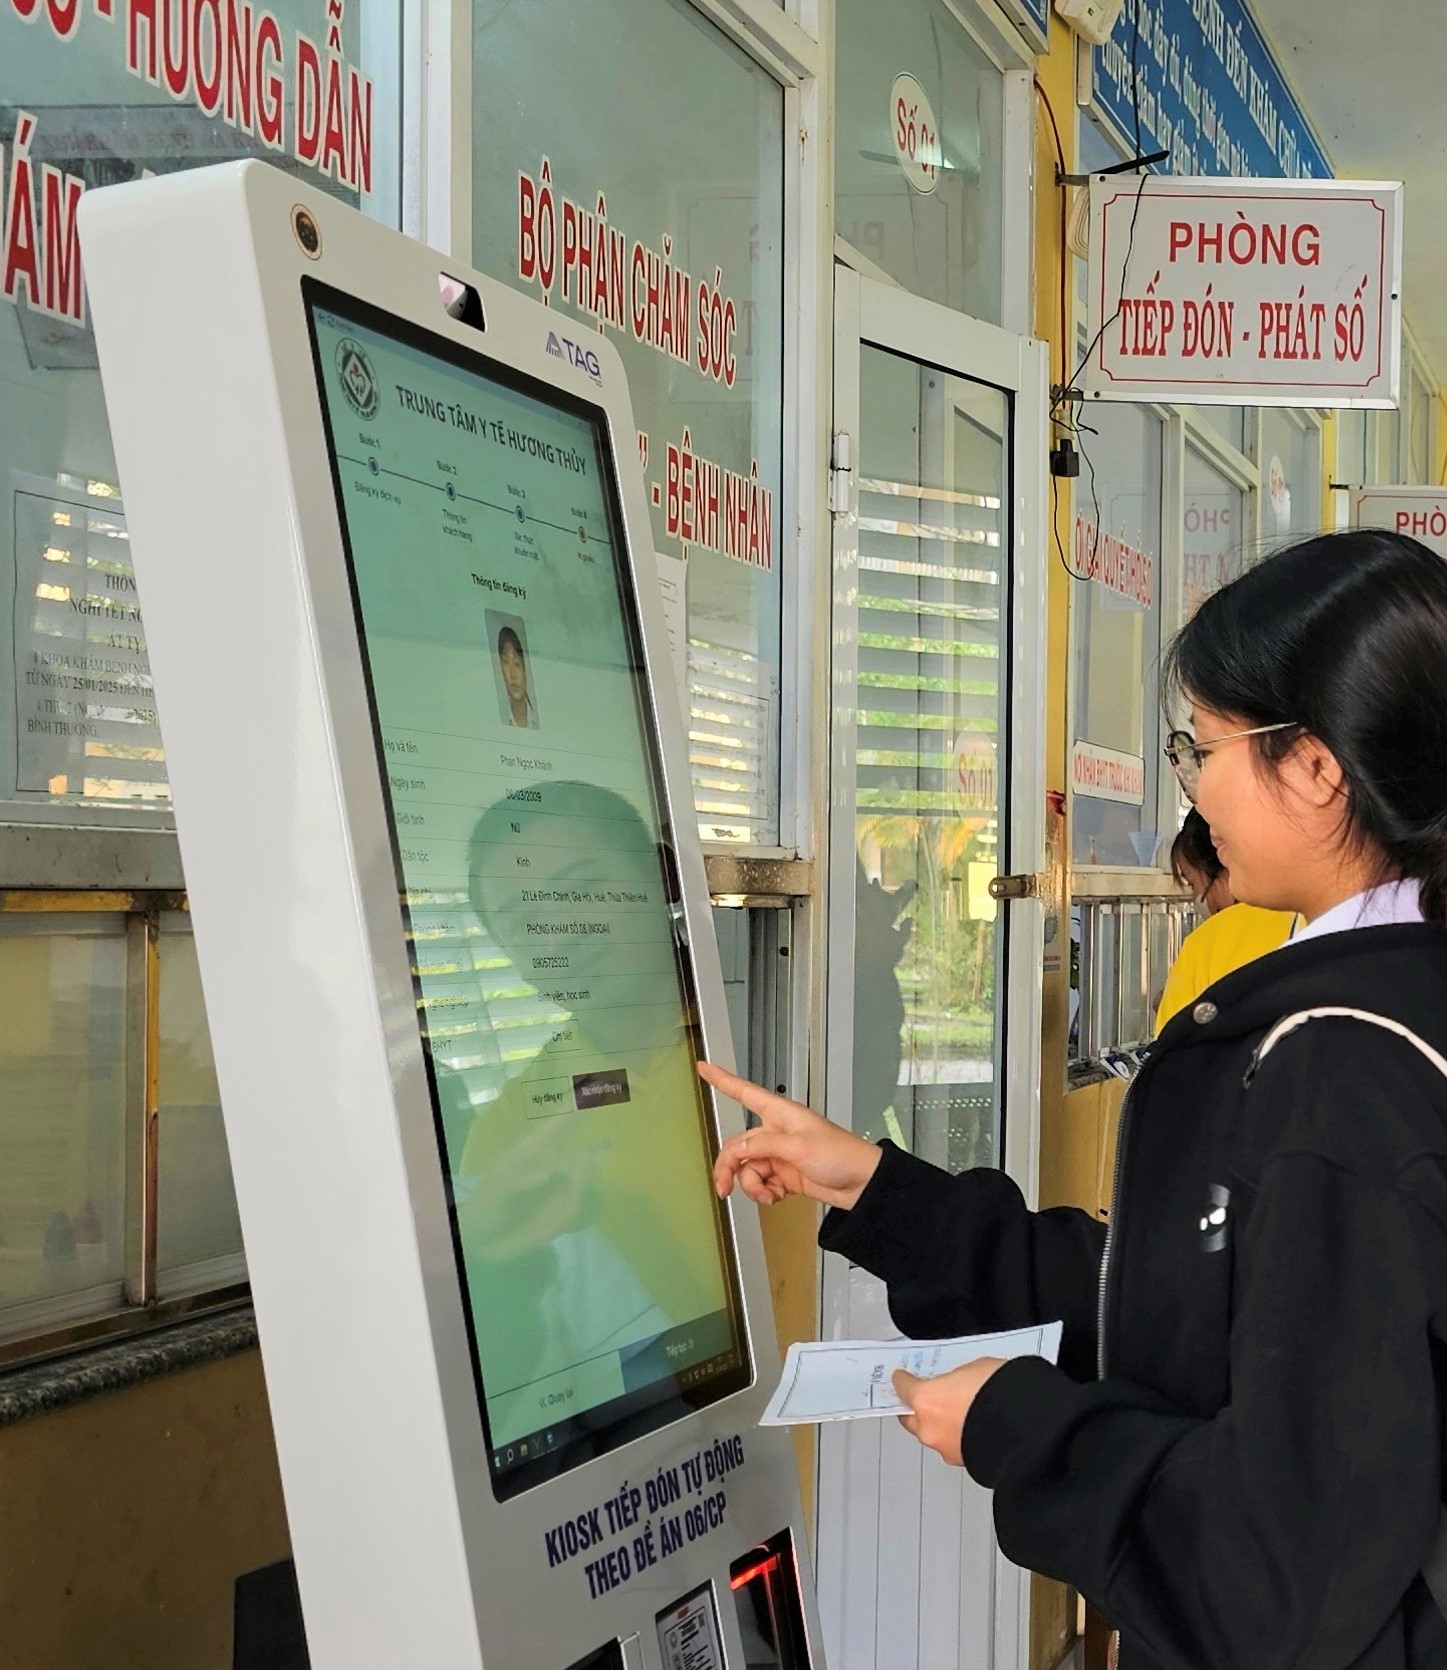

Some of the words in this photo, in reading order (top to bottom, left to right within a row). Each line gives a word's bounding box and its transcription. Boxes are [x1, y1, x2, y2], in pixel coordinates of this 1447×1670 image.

[297, 0, 373, 194] DẪN
[897, 97, 918, 161] Số
[520, 160, 555, 307] BỘ
[562, 196, 625, 335] PHẬN
[632, 235, 690, 362] CHĂM
[698, 269, 737, 387] SÓC
[1168, 210, 1321, 267] PHÒNG
[561, 337, 602, 377] TAG
[1118, 270, 1175, 357] TIẾP
[1181, 282, 1235, 359] ĐÓN
[1258, 284, 1327, 361] PHÁT
[1333, 274, 1368, 362] SỐ
[395, 384, 446, 423] TRUNG
[447, 403, 478, 435] TÂM
[478, 416, 487, 438] Y
[489, 420, 506, 445] TẾ
[506, 428, 555, 464] HƯƠNG
[555, 446, 586, 476] THỦY
[668, 430, 720, 560] BỆNH
[724, 460, 772, 570] NHÂN
[544, 1507, 604, 1568] KIOSK
[604, 1480, 641, 1535] TIẾP
[645, 1466, 681, 1514] ĐÓN
[681, 1452, 703, 1496] TỰ
[703, 1434, 745, 1483] ĐỘNG
[584, 1545, 631, 1600] THEO
[632, 1520, 658, 1573] ĐỀ
[658, 1516, 684, 1559] ÁN
[684, 1490, 727, 1542] 06/CP
